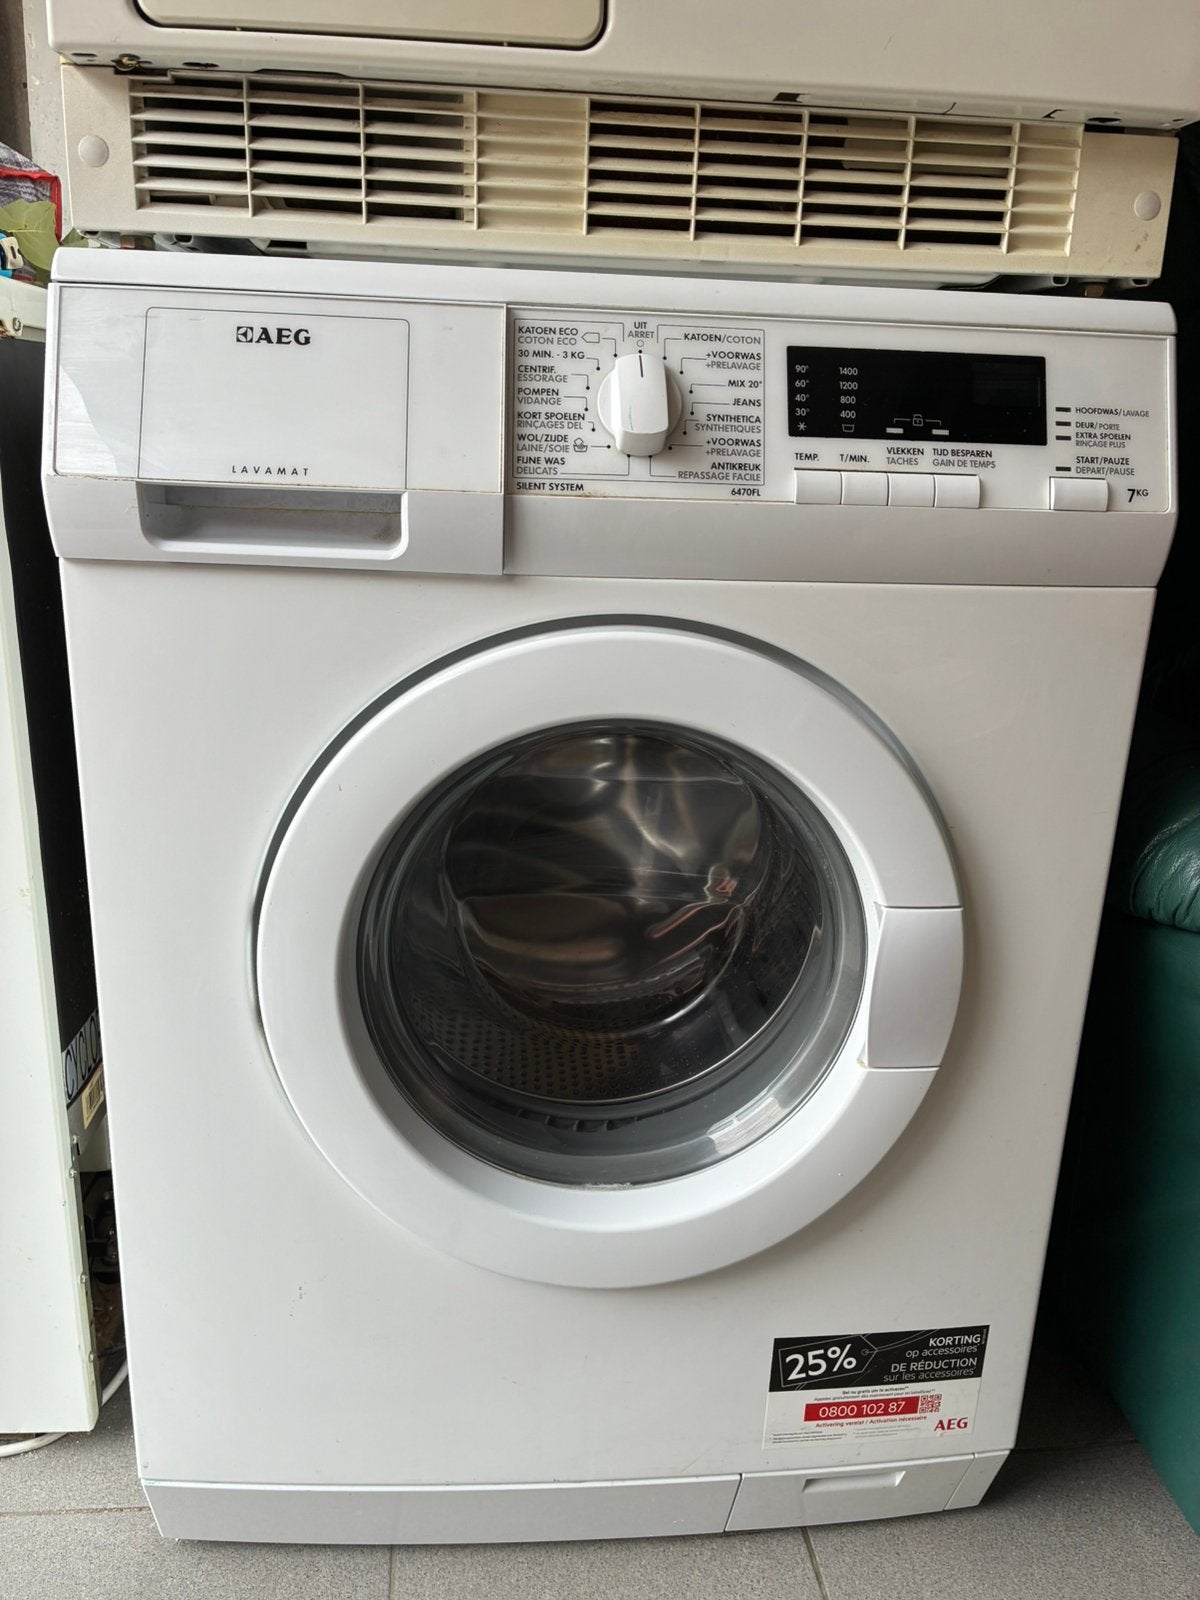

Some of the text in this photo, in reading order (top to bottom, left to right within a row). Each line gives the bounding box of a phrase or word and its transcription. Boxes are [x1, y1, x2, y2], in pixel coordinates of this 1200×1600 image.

[634, 321, 647, 329] UIT
[254, 326, 311, 346] AEG
[518, 326, 578, 336] KATOEN ECO
[627, 331, 654, 339] ARRET
[518, 336, 577, 346] COTON ECO
[684, 333, 760, 344] KATOEN/COTON
[518, 349, 529, 358] 30
[532, 350, 554, 358] MIN.
[562, 351, 568, 359] 3
[571, 351, 585, 359] KG
[706, 351, 761, 360] +VOORWAS
[517, 365, 556, 374] CENTRIF.
[706, 361, 761, 371] +PRELAVAGE
[840, 367, 858, 375] 1400
[517, 373, 568, 383] ESSORAGE
[727, 380, 746, 388] MIX
[839, 381, 858, 390] 1200
[517, 387, 559, 396] POMPEN
[517, 397, 562, 405] VIDANGE
[732, 398, 761, 407] JEANS
[840, 395, 856, 404] 800
[517, 411, 585, 421] KORT SPOELEN
[706, 413, 761, 424] SYNTHETICA
[840, 410, 856, 419] 400
[517, 420, 583, 430] RINÇAGES DEL
[694, 423, 761, 434] SYNTHETIQUES
[517, 433, 569, 443] WOL/ZIJDE
[706, 438, 761, 447] +VOORWAS
[517, 443, 570, 453] LAINE/SOIE
[1075, 440, 1107, 448] RINÇAGE
[705, 448, 761, 458] +PRELAVAGE
[886, 446, 924, 456] VLEKKEN
[932, 448, 992, 458] TIJD BESPAREN
[517, 456, 565, 465] FIJNE WAS
[795, 452, 820, 462] TEMP.
[840, 453, 870, 463] T/MIN.
[886, 456, 919, 466] TACHES
[1076, 456, 1130, 465] START/PAUZE
[710, 462, 761, 471] ANTIKREUK
[932, 458, 996, 469] GAIN DE TEMPS
[232, 465, 308, 476] LAVAMAT
[516, 466, 558, 475] DELICATS
[678, 470, 761, 481] REPASSAGE FACILE
[516, 482, 584, 491] SILENT SYSTEM
[731, 488, 761, 496] 6470FL
[929, 1334, 981, 1347] KORTING
[905, 1350, 919, 1358] op
[785, 1344, 857, 1380] 25%
[891, 1357, 977, 1373] DE RÉDUCTION
[883, 1374, 899, 1382] sur
[902, 1372, 916, 1380] les
[819, 1401, 905, 1418] 0800 102 87
[933, 1417, 968, 1432] AEG
